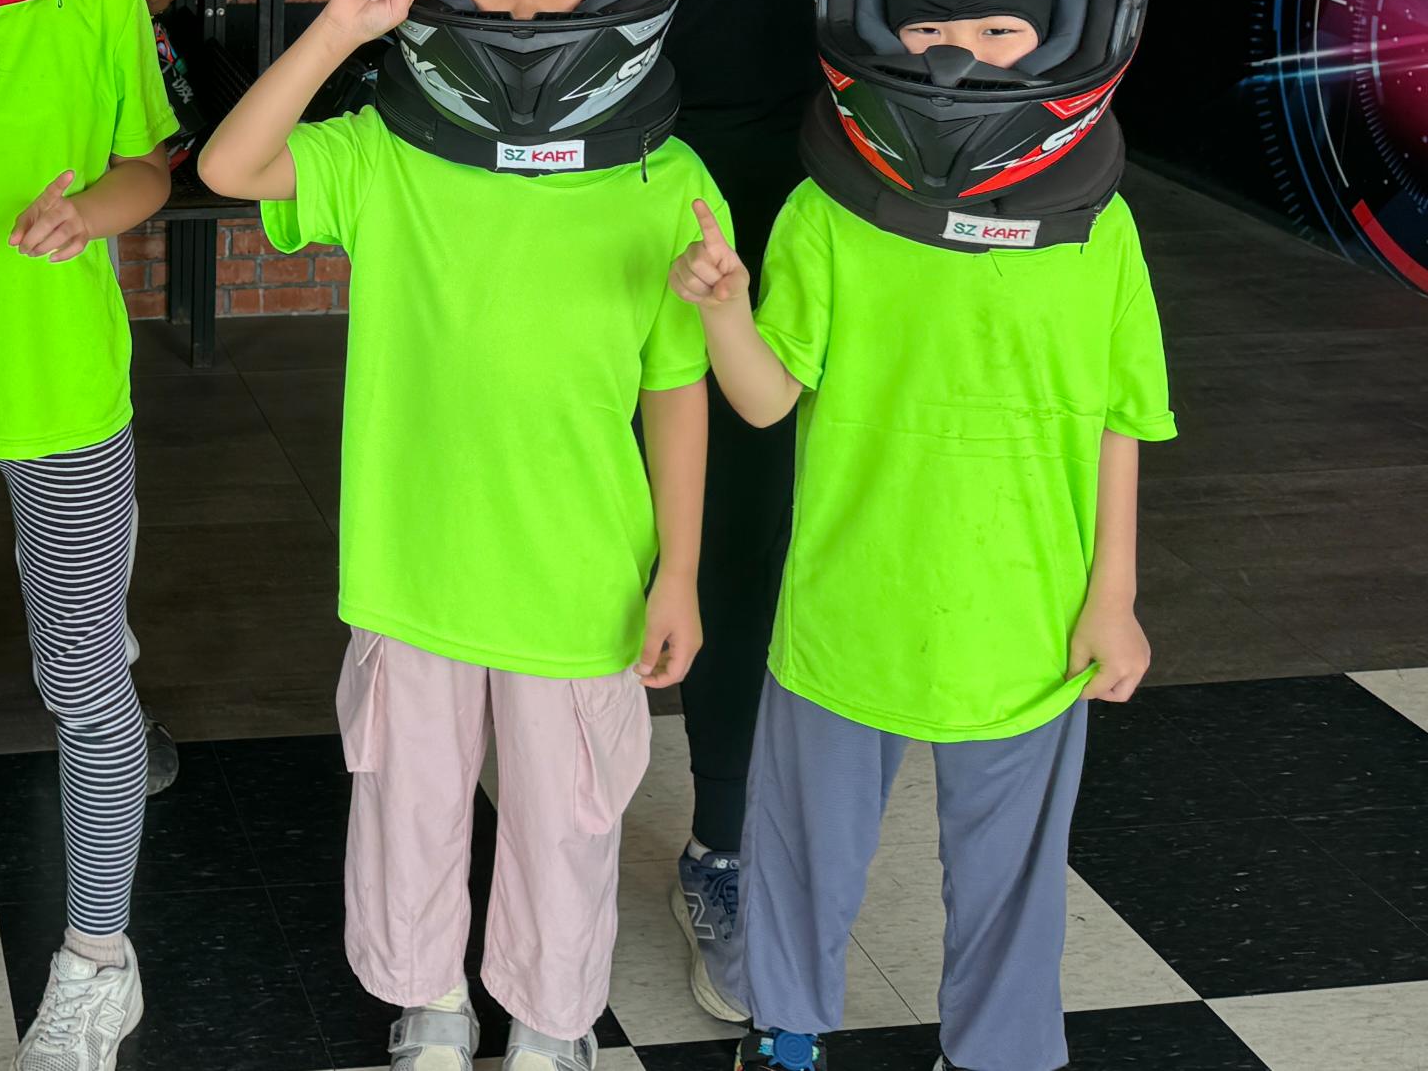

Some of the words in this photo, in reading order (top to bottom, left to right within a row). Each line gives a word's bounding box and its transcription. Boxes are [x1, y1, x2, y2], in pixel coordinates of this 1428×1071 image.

[504, 148, 526, 162] SZ
[531, 150, 578, 163] KART
[953, 222, 978, 236] SZ
[981, 225, 1031, 240] KART
